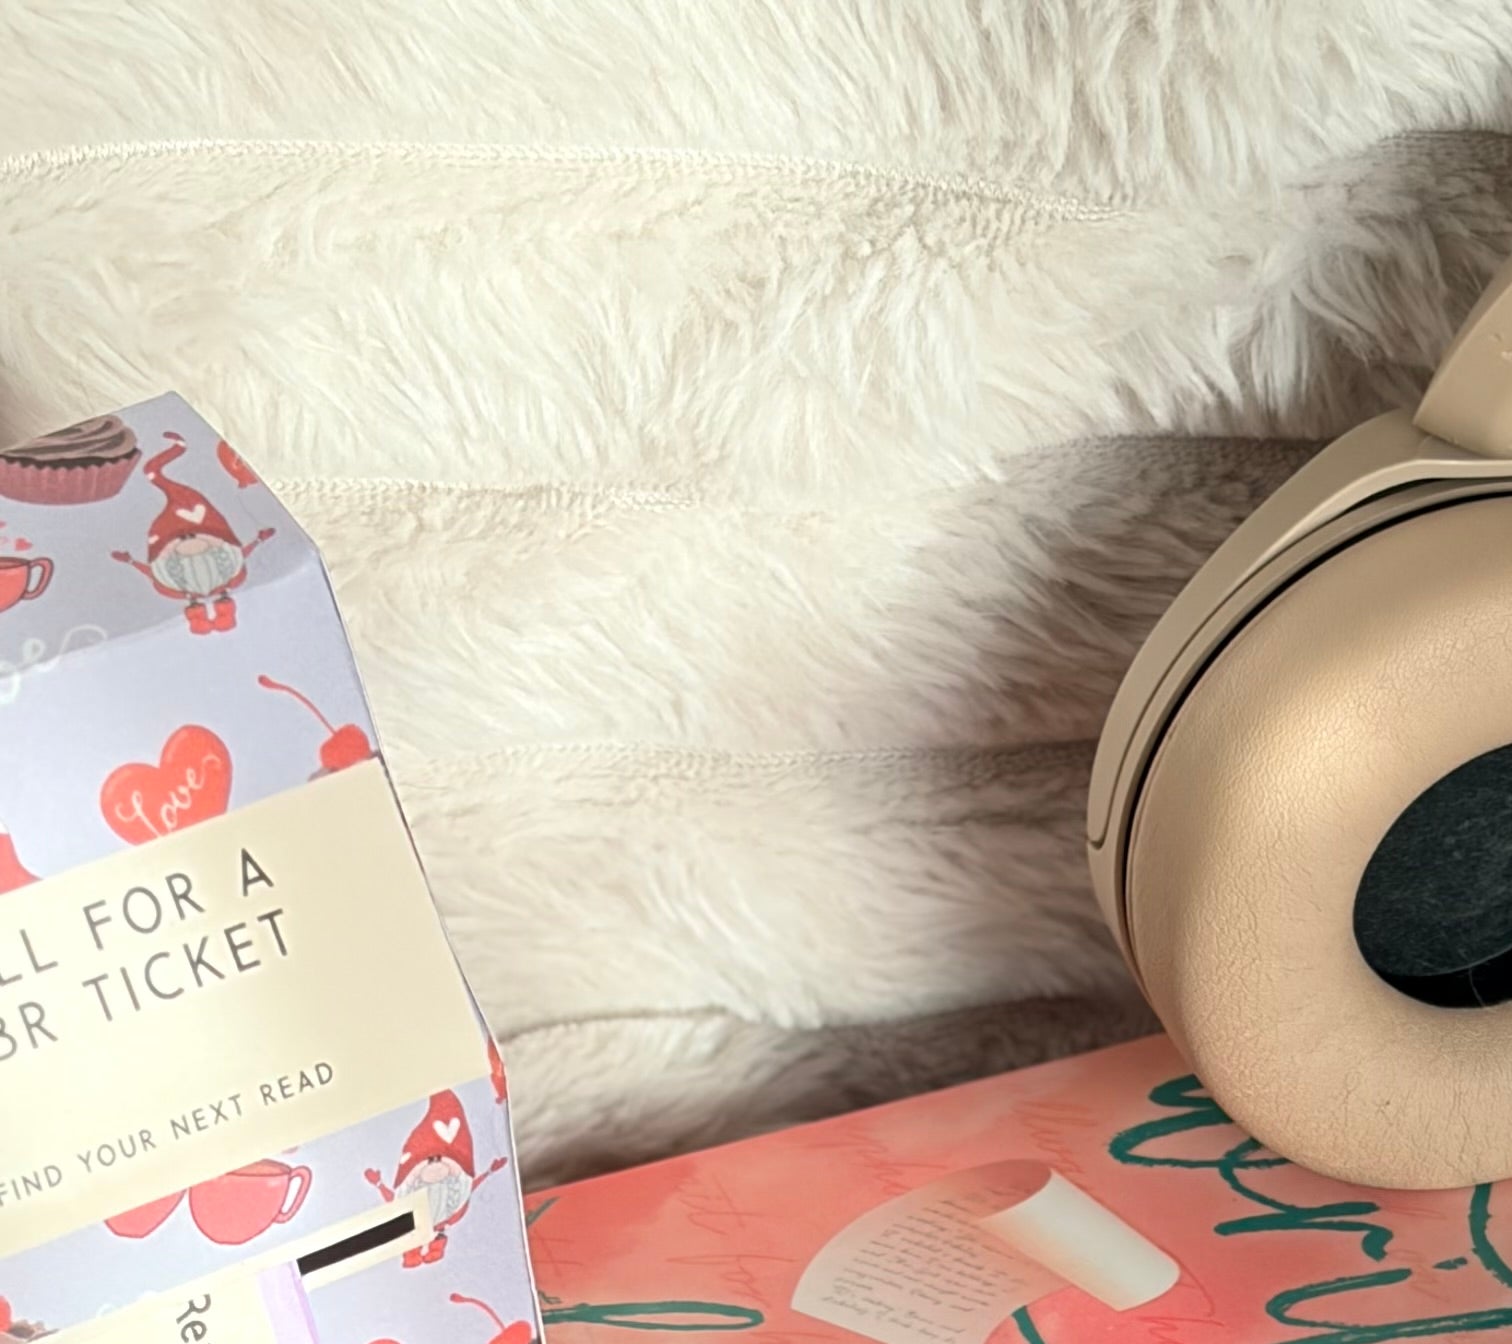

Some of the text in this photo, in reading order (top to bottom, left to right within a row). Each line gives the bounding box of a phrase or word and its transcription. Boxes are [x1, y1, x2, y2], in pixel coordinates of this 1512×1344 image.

[81, 871, 206, 951] FOR
[240, 847, 275, 898] A
[81, 907, 288, 1022] TICKET
[76, 1128, 157, 1175] YOUR
[168, 1093, 243, 1141] NEXT
[259, 1061, 334, 1107] READ
